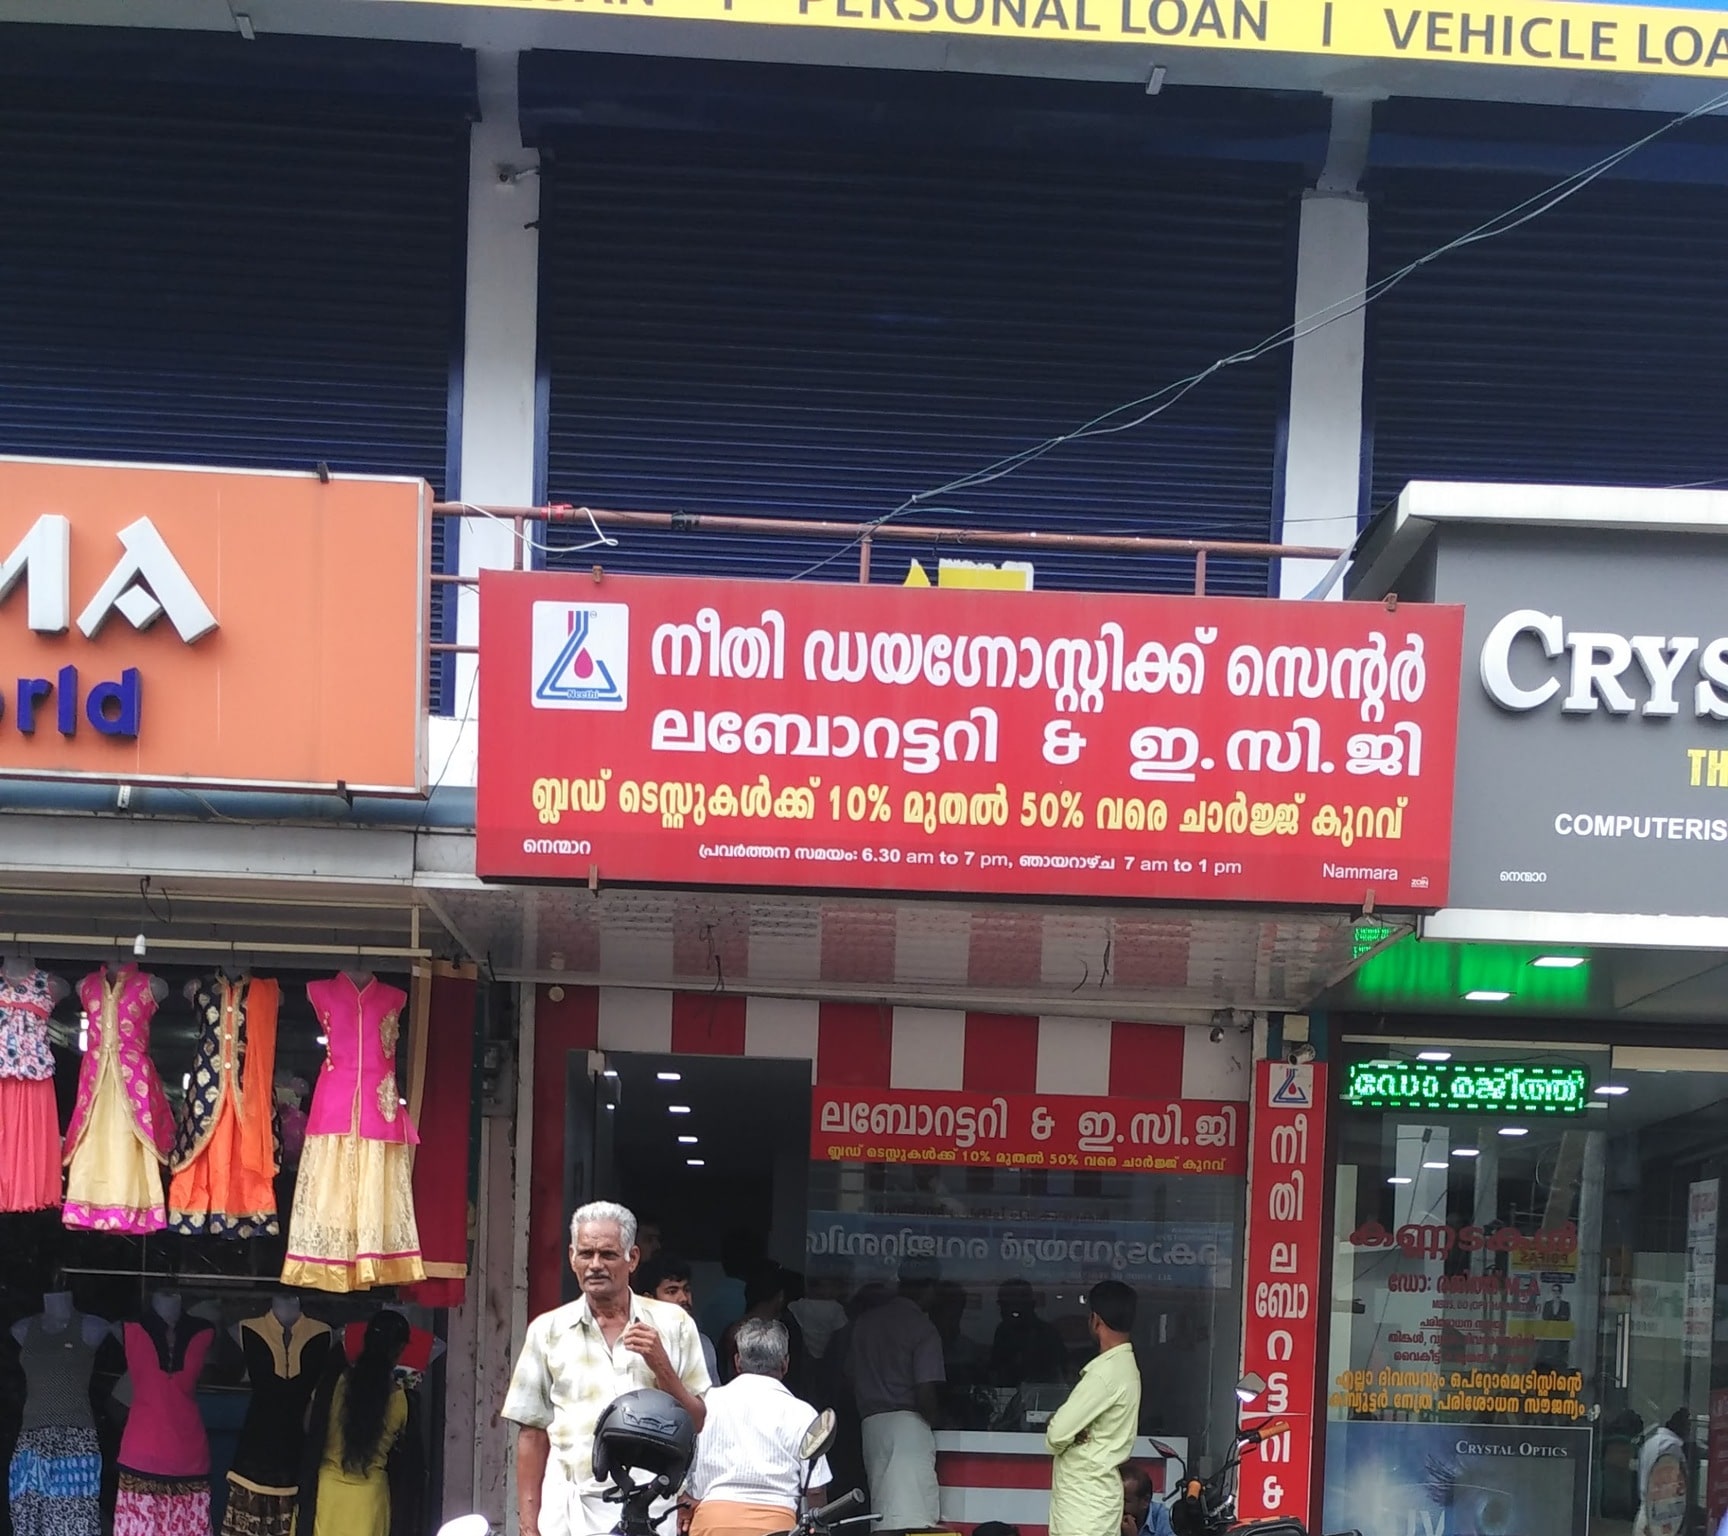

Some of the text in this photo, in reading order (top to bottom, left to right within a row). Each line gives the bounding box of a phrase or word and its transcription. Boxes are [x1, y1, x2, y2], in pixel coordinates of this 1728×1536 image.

[1121, 0, 1267, 41] LOAN
[1385, 9, 1618, 62] VEHICLE
[651, 607, 785, 680] നീതി
[0, 664, 140, 738] rld
[651, 706, 999, 774] ലബോറട്ടറി
[1042, 720, 1087, 765] &
[532, 768, 612, 824] ബ്ലഡ്
[829, 784, 892, 822] 10%
[903, 783, 1009, 834] മുതൽ
[1020, 790, 1085, 829] 50%
[1096, 797, 1168, 831] വരെ
[1312, 797, 1408, 847] കുറവ്
[699, 844, 790, 859] പ്രവർത്തന
[861, 848, 900, 863] 6.30
[906, 852, 934, 865] am
[939, 852, 960, 866] to
[964, 851, 976, 866] 7
[980, 854, 1013, 869] pm,
[1019, 853, 1115, 870] ഞായറാഴ്ച
[1124, 856, 1136, 871] 7
[1140, 858, 1168, 872] am
[1173, 858, 1193, 873] to
[1198, 859, 1207, 873] 1
[1214, 861, 1242, 877] pm
[1322, 863, 1398, 881] Nammara
[820, 1097, 1008, 1148] ലബോറട്ടറി
[1030, 1107, 1055, 1140] &
[828, 1144, 864, 1161] ബ്ലഡ്
[962, 1150, 991, 1162] 10%
[996, 1151, 1044, 1167] മുതൽ
[1049, 1154, 1079, 1166] 50%
[1084, 1154, 1117, 1167] വരെ
[1182, 1156, 1227, 1173] കുറവ്
[1335, 1368, 1373, 1392] എല്ലാ
[1378, 1366, 1446, 1392] ദിവസവും
[1437, 1391, 1519, 1413] പരിശോധന
[1455, 1440, 1568, 1458] CRYSTAL OPTICS
